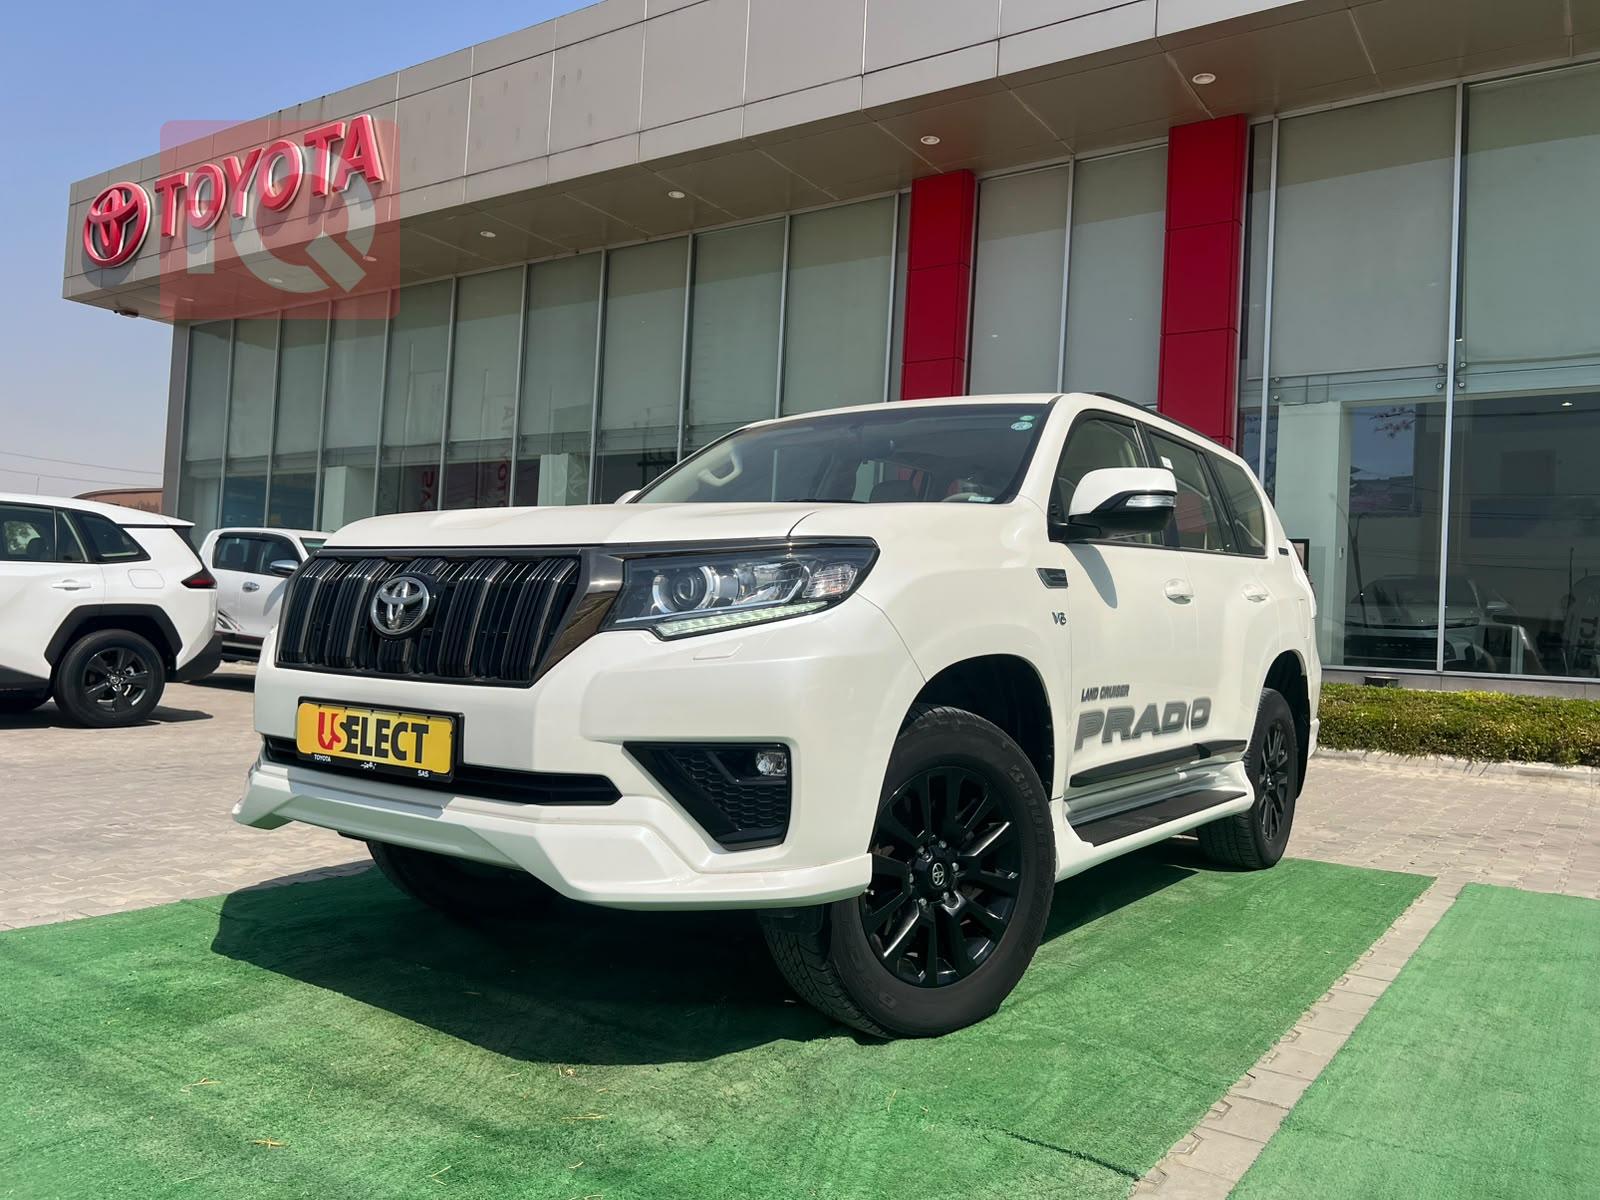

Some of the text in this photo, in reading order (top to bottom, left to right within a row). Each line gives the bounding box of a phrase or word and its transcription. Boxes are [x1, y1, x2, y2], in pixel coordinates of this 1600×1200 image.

[154, 114, 385, 238] TOYOTA
[1081, 684, 1130, 702] LAND CRUISER
[1074, 698, 1211, 752] PRADO
[314, 754, 332, 762] TOYOTA
